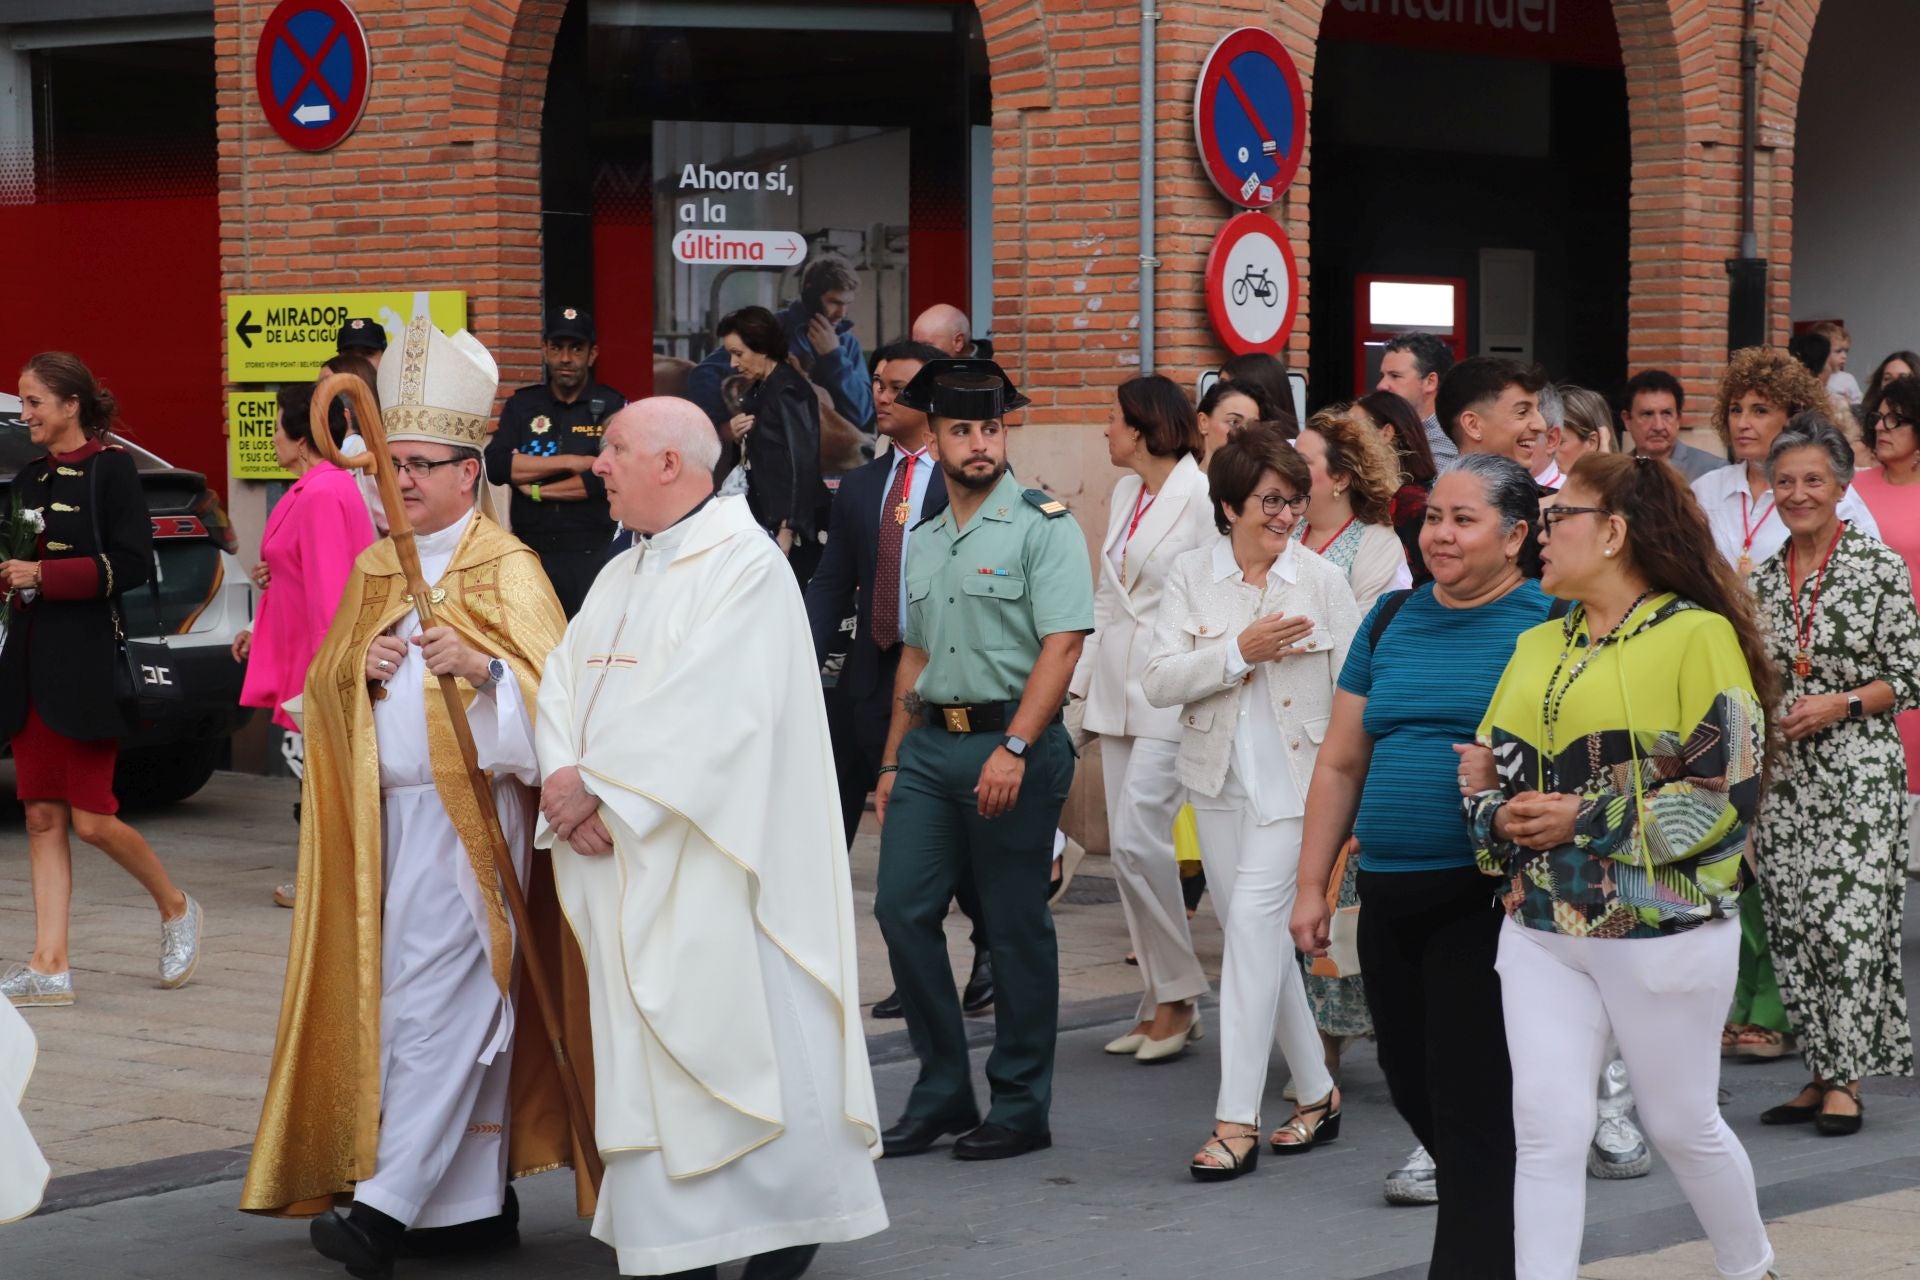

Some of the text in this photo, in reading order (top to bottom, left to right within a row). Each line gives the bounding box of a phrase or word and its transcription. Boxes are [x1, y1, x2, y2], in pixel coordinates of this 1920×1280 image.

[679, 163, 794, 196] Ahora sí,
[680, 197, 727, 223] a la
[681, 233, 764, 260] última
[266, 306, 349, 327] MIRADOR
[266, 325, 338, 343] DE LAS CIGÜ
[237, 401, 276, 418] CENT
[239, 420, 277, 438] INTE
[239, 441, 250, 450] DE
[253, 440, 268, 450] LOS
[239, 453, 246, 462] Y
[246, 453, 262, 462] SUS
